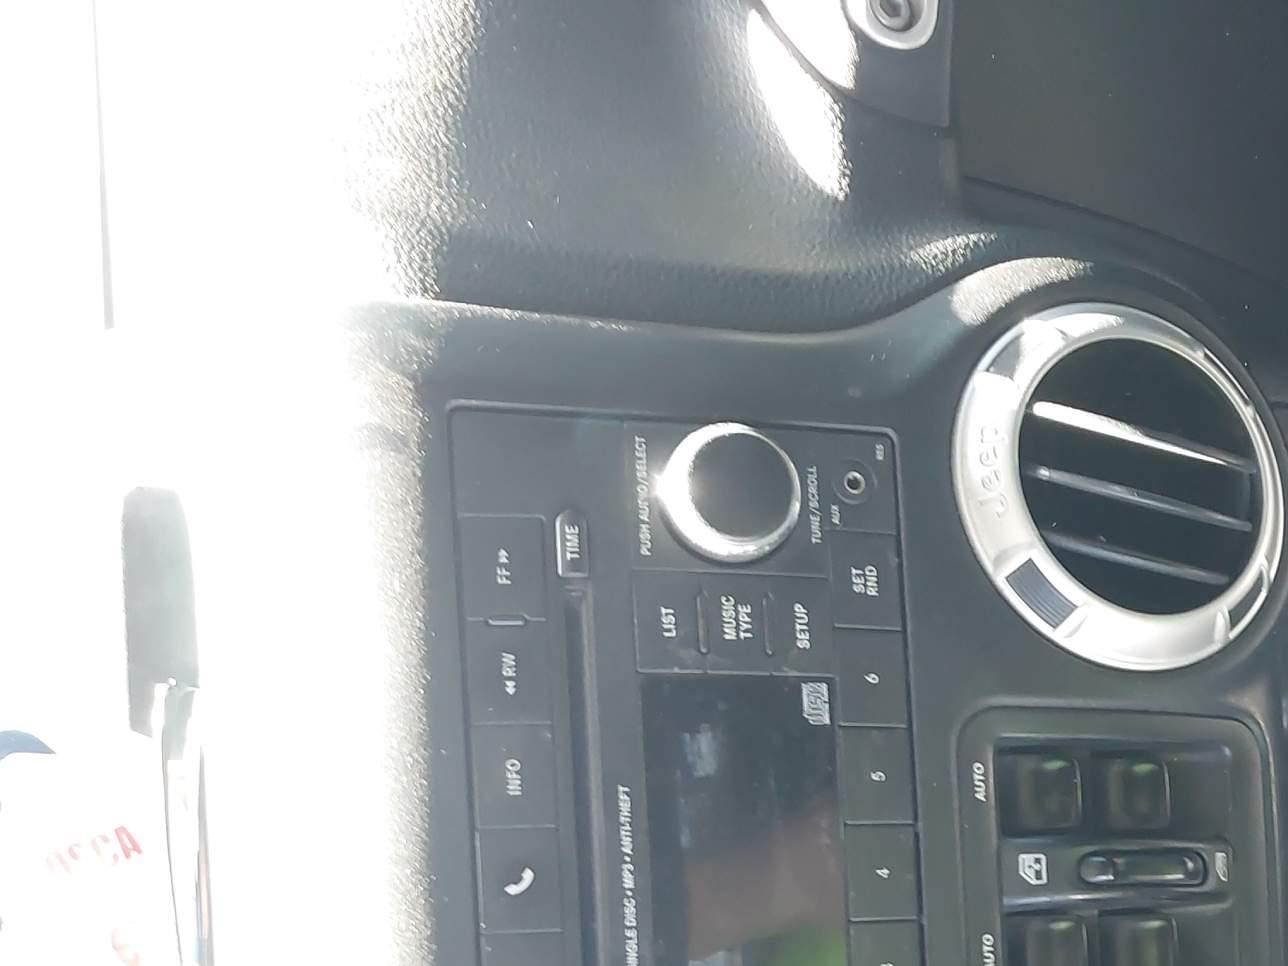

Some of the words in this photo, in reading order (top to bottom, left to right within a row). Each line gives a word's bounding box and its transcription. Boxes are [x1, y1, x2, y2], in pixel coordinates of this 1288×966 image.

[808, 466, 821, 543] TUNE/SCROLL
[831, 504, 840, 525] AUX
[565, 525, 579, 560] TIME
[639, 523, 652, 556] PUSH
[497, 568, 511, 584] FF
[851, 567, 864, 593] SET
[863, 566, 878, 595] RND
[661, 607, 676, 636] LIST
[721, 596, 736, 639] MUSIC
[738, 605, 752, 639] TYPE
[794, 604, 810, 649] SETUP
[502, 653, 516, 676] RW
[864, 674, 879, 683] 6
[506, 759, 521, 795] INFO
[871, 772, 885, 780] 5
[973, 762, 986, 802] AUTO
[622, 864, 634, 888] MP3
[876, 869, 889, 878] 4
[624, 898, 636, 926] DISC
